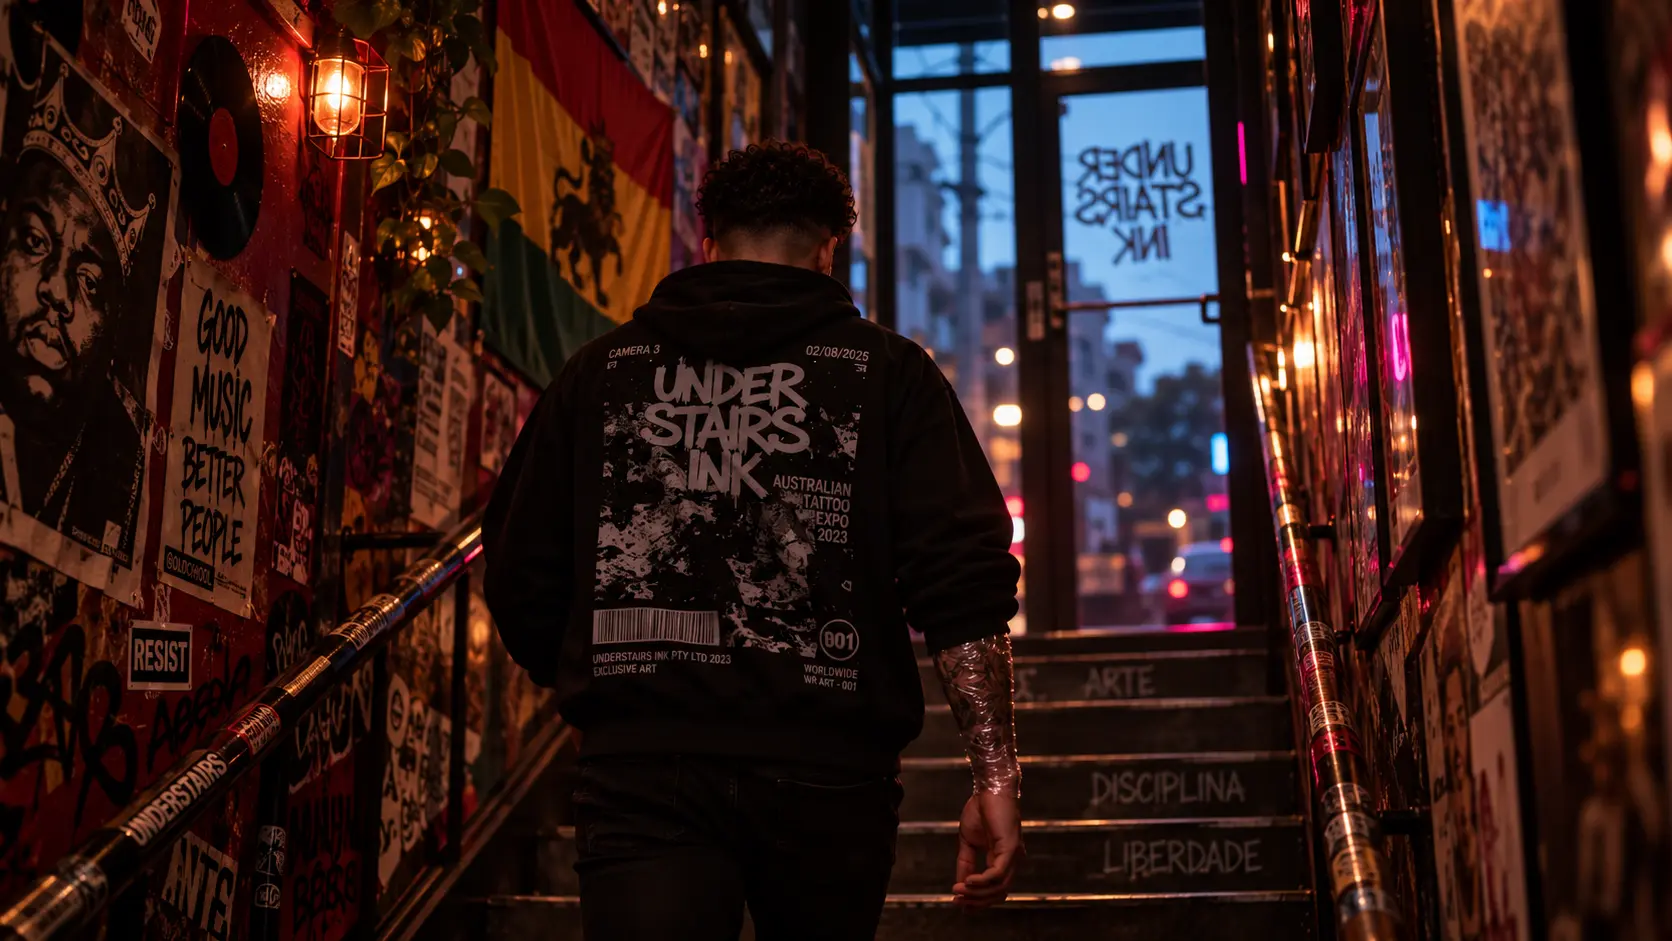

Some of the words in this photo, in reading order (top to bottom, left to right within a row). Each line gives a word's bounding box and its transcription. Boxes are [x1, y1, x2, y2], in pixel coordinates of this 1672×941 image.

[197, 288, 249, 367] GOOD
[608, 344, 651, 360] CAMERA
[653, 344, 661, 355] 3
[653, 357, 810, 410] UNDER
[640, 402, 811, 456] STAIRS
[182, 436, 246, 508] BETTER
[687, 449, 770, 502] INK
[772, 473, 852, 497] AUSTRALIAN
[803, 493, 851, 513] TATTOO
[815, 511, 850, 529] EXPO
[180, 499, 244, 568] PEOPLE
[817, 527, 848, 544] 2023
[133, 637, 189, 673] RESIST
[592, 651, 653, 664] UNDERSTAIRS
[654, 650, 669, 661] INK
[671, 650, 689, 661] PTY
[691, 652, 708, 663] LTD
[709, 653, 732, 665] 2023
[593, 663, 637, 678] EXCLUSIVE
[639, 663, 658, 674] ART
[803, 663, 859, 680] WORLDWIDE
[803, 674, 818, 686] WR
[819, 677, 835, 689] ART
[842, 680, 857, 692] 001
[1084, 664, 1156, 698] ARTE
[120, 752, 229, 847] UNDERSTAIRS
[1091, 770, 1247, 806] DISCIPLINA
[1102, 838, 1263, 876] LIBERDADE
